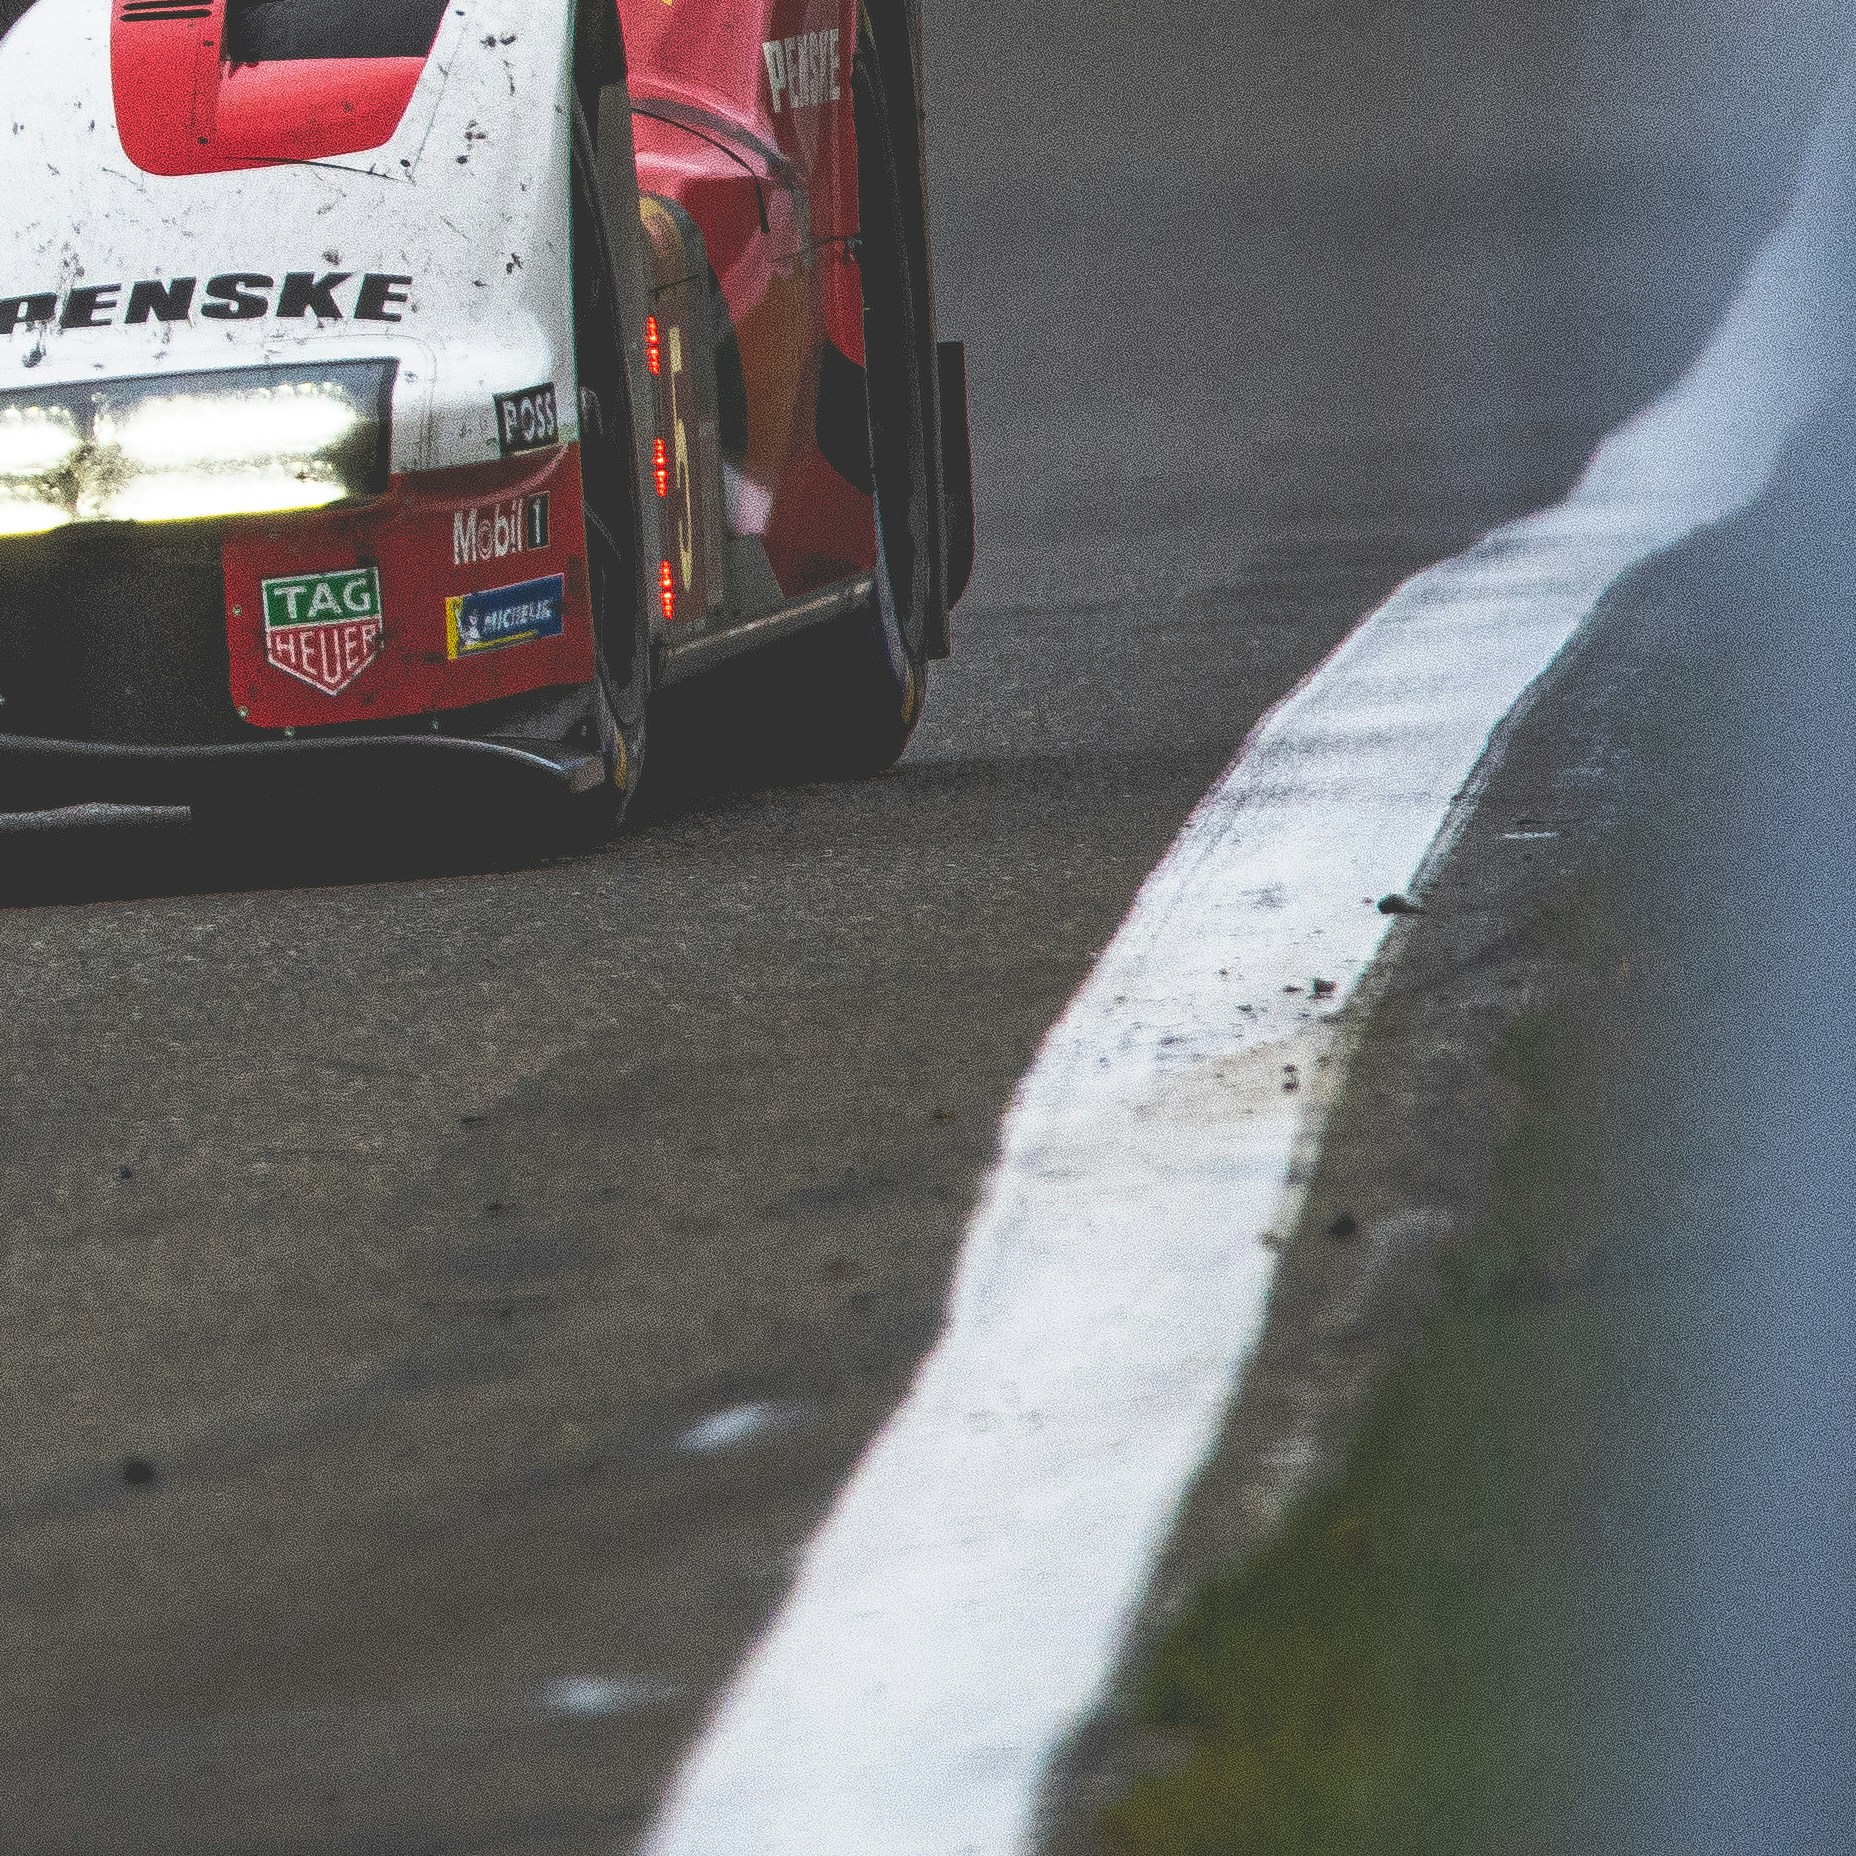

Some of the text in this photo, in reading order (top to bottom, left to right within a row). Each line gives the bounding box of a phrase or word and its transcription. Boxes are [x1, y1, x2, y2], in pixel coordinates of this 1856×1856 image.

[761, 28, 841, 113] PENSKE
[453, 499, 523, 565] Mobil
[274, 578, 371, 620] TAG
[276, 623, 379, 684] HEUER
